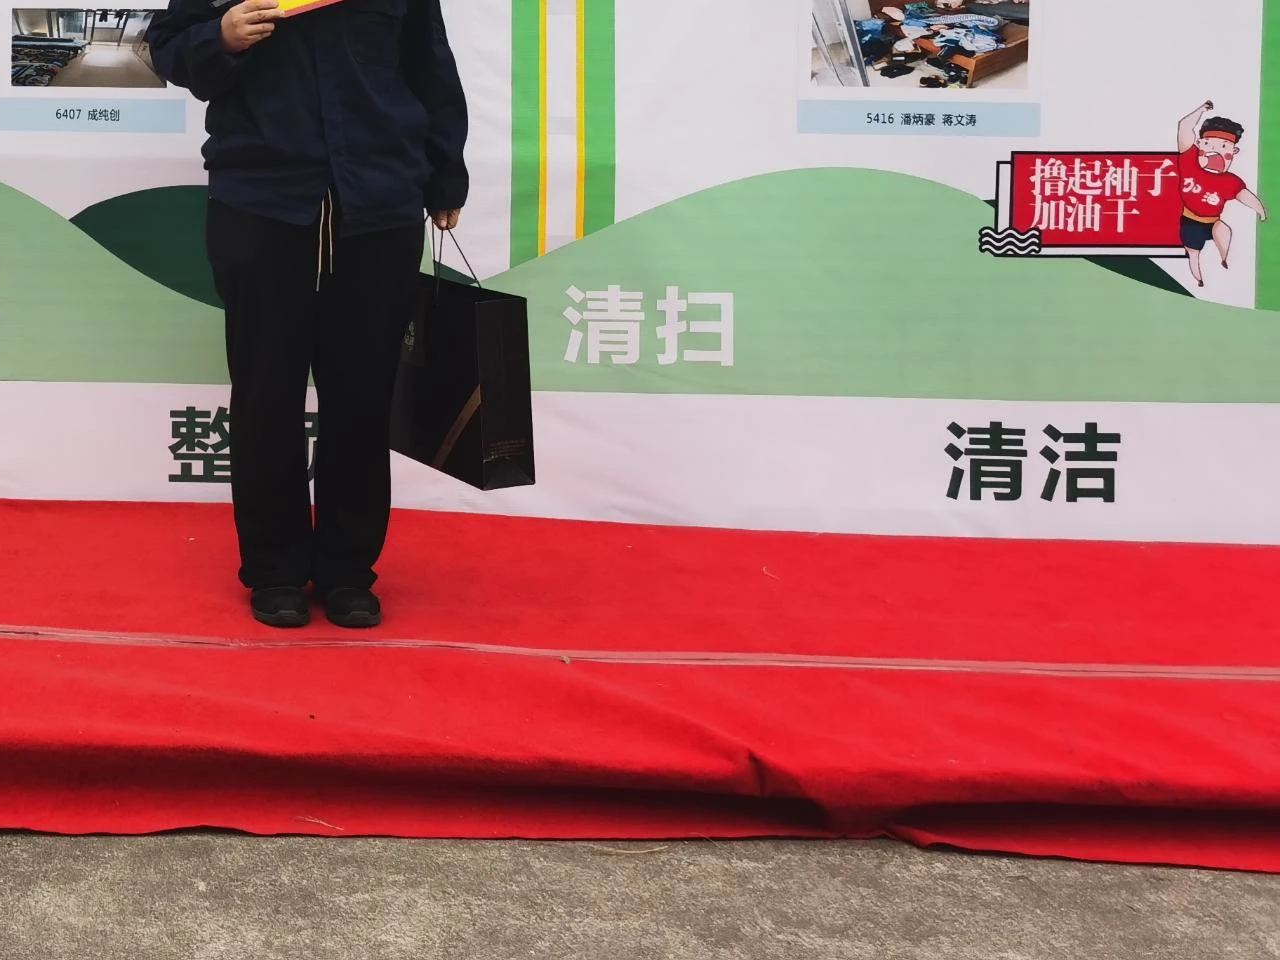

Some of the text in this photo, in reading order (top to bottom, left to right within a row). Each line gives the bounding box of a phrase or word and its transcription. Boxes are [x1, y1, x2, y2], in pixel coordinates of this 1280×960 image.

[55, 108, 121, 122] 6407 成纯创
[866, 112, 896, 126] 5416
[941, 113, 977, 127] 蒋文涛
[1029, 157, 1177, 197] 撸起袖子
[1029, 194, 1141, 233] 加油干
[562, 284, 735, 367] 清扫
[943, 420, 1122, 503] 清洁
